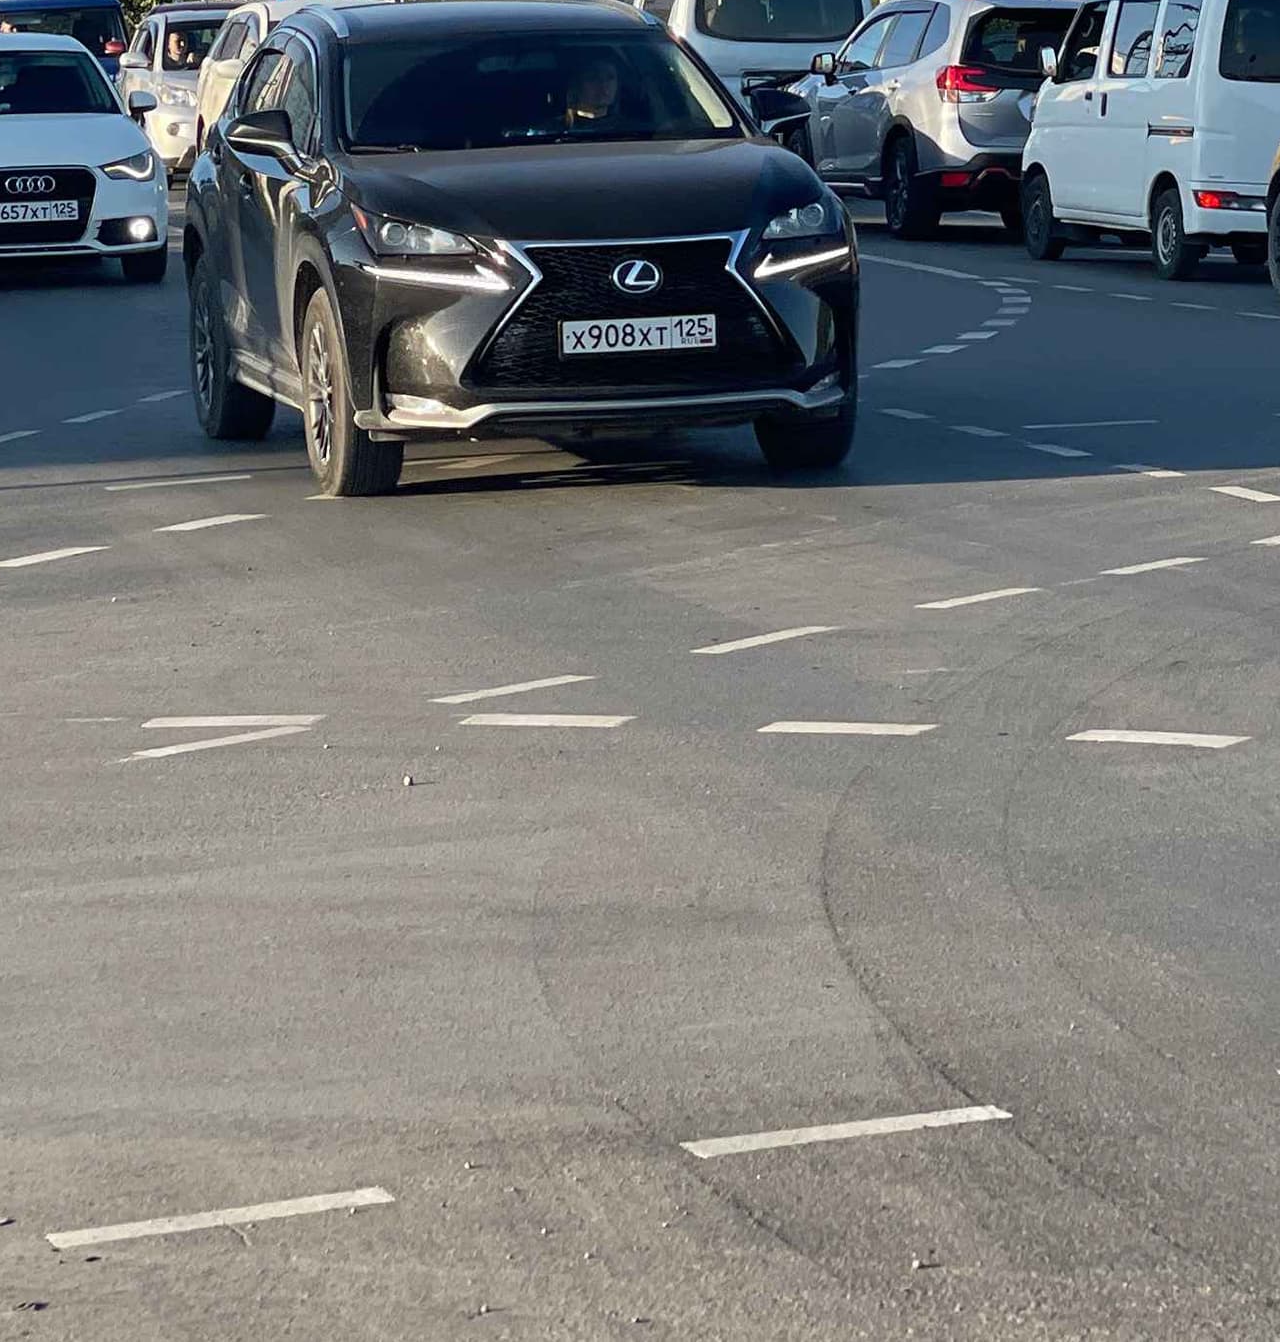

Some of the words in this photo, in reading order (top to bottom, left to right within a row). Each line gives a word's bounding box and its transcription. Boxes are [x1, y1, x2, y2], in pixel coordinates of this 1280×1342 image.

[52, 202, 74, 215] 125
[572, 323, 668, 349] Х908ХТ
[673, 317, 708, 337] 125
